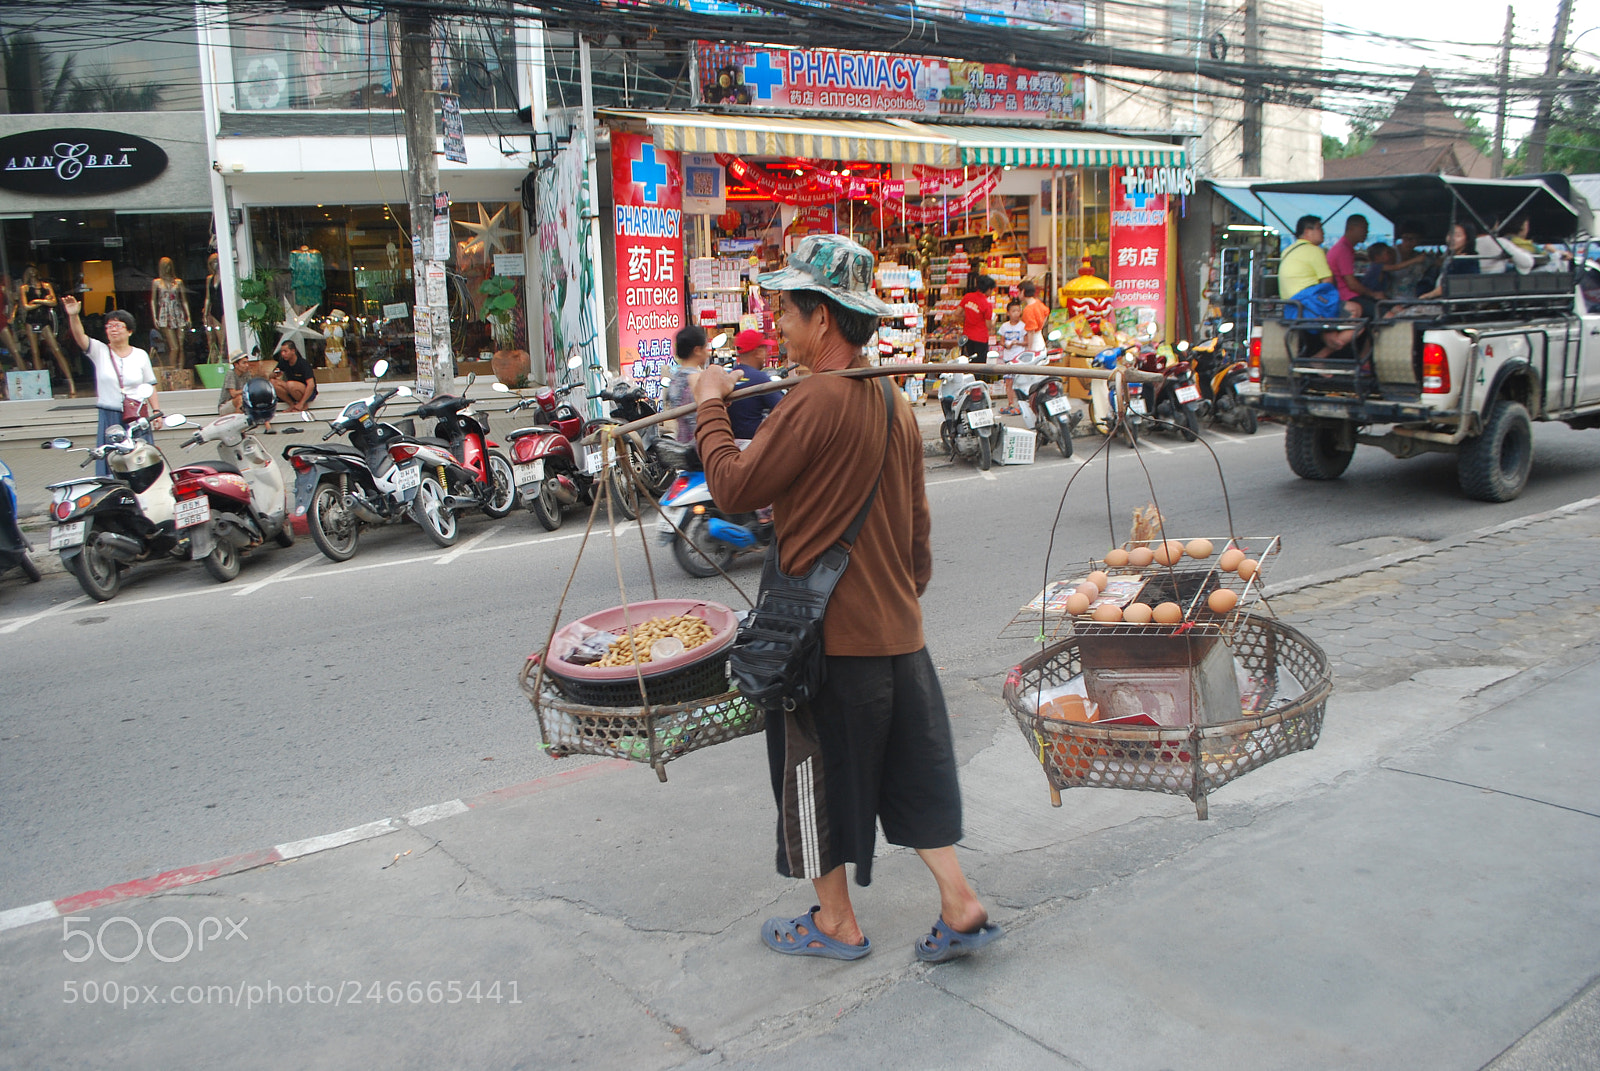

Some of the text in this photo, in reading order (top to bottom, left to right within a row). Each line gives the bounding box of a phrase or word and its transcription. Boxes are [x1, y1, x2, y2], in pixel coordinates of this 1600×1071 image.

[789, 51, 922, 91] PHARMACY
[969, 71, 1066, 93] 礼品店 最便宜价
[789, 90, 814, 105] 药店
[820, 91, 871, 108] аптека
[875, 95, 925, 111] Apotheke
[964, 91, 1018, 111] 热销产品
[761, 177, 775, 189] SALE
[817, 174, 831, 185] SALE
[813, 193, 826, 201] SALE
[616, 205, 681, 238] PHARMACY
[1112, 210, 1166, 226] PHARMACY
[627, 245, 675, 282] 药店
[1117, 247, 1159, 267] 药店
[1114, 278, 1160, 290] аптека
[626, 287, 678, 306] аптека
[1114, 291, 1160, 303] Apotheke
[626, 310, 679, 334] Apotheke
[638, 338, 671, 358] 礼品店
[184, 514, 202, 525] 969
